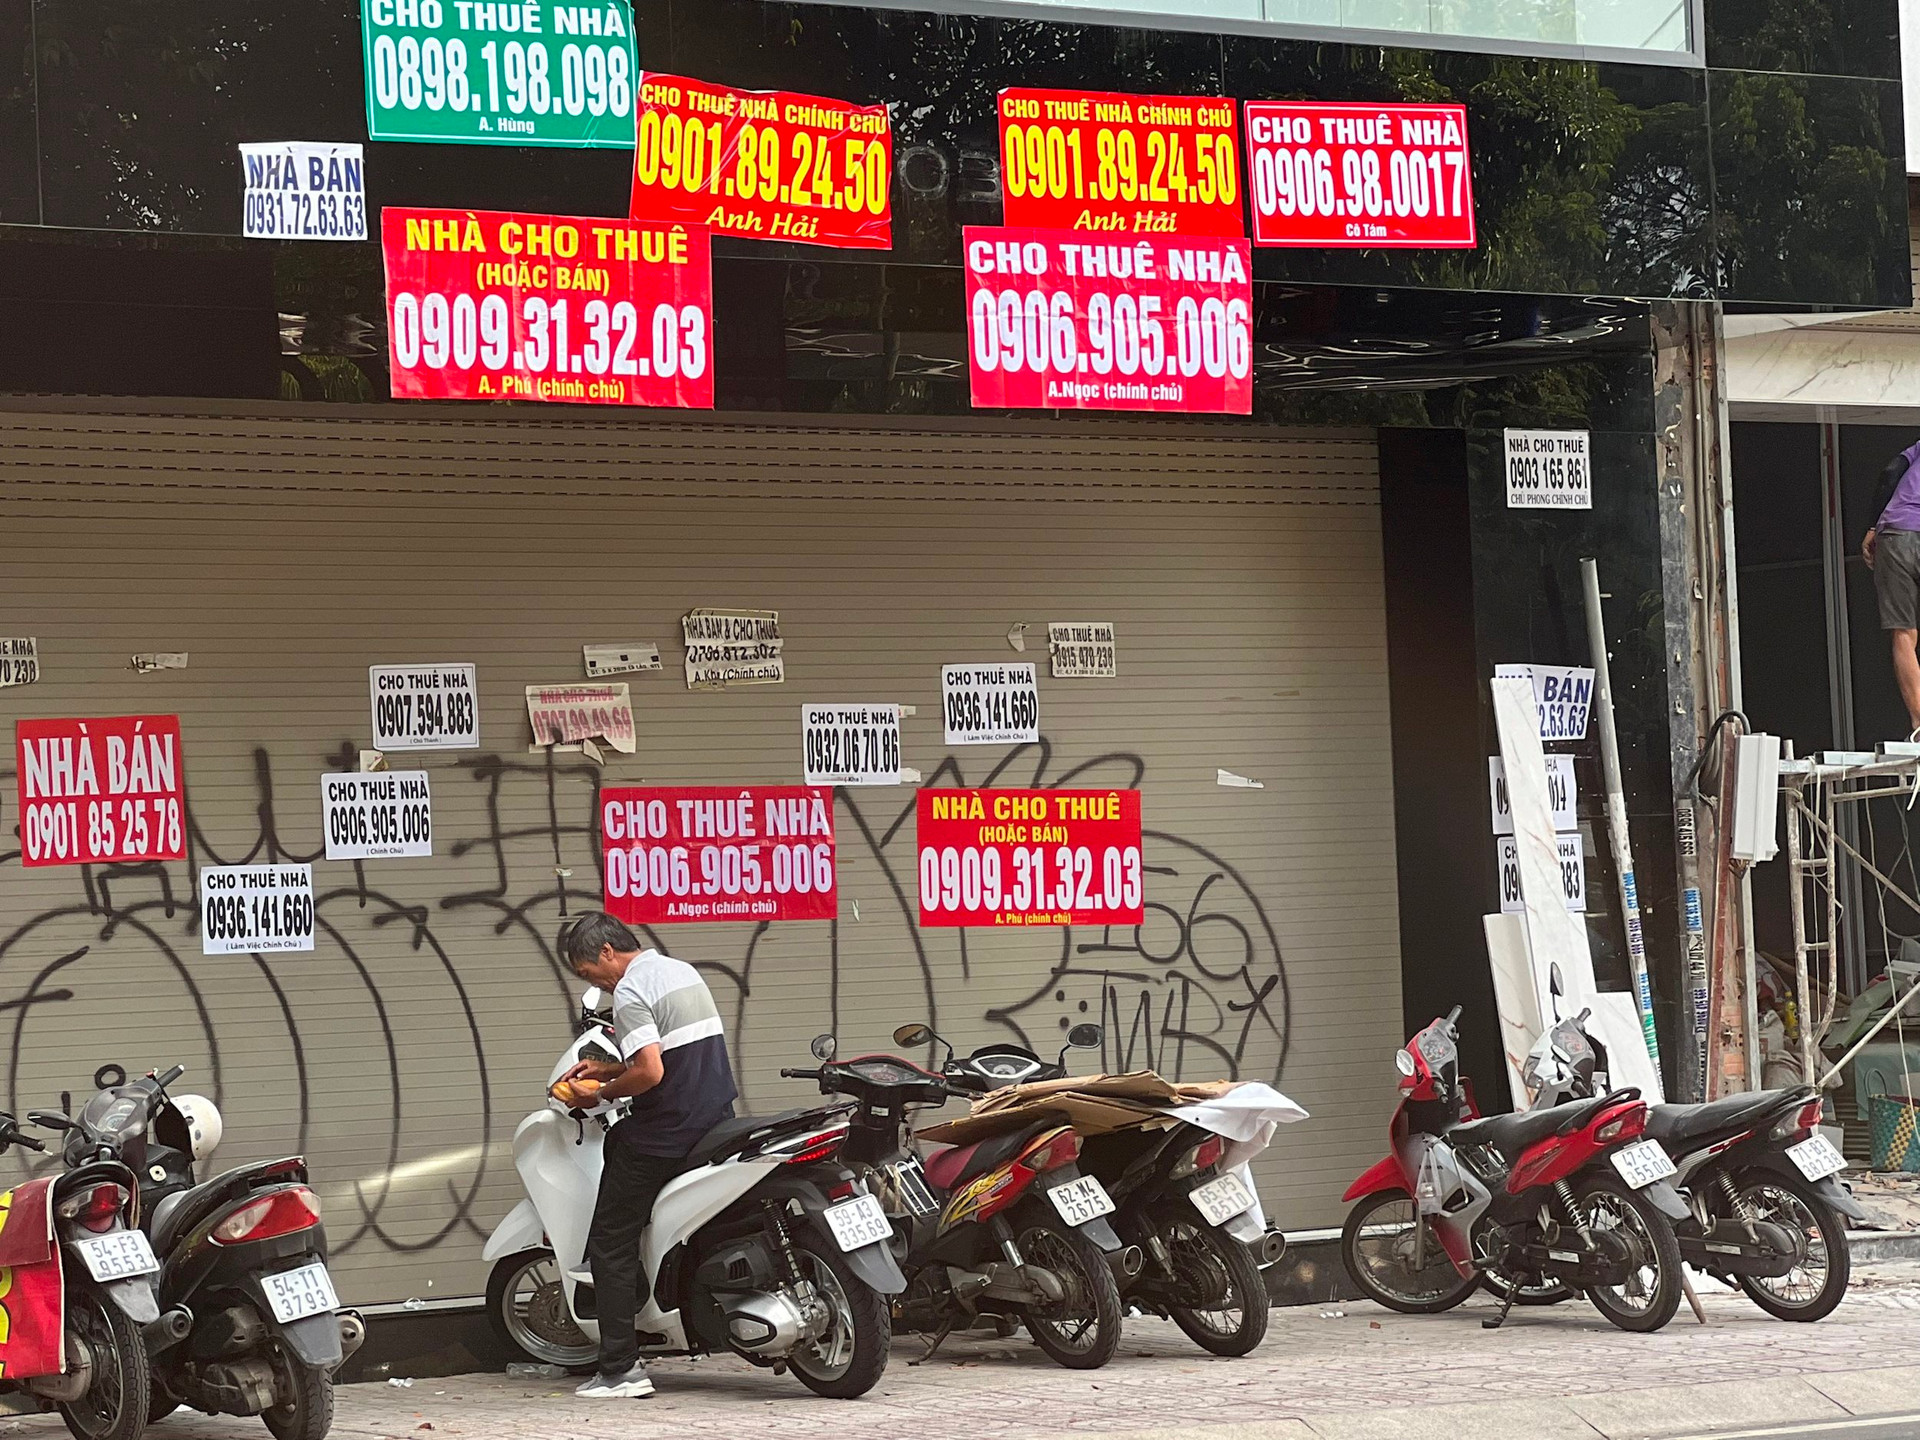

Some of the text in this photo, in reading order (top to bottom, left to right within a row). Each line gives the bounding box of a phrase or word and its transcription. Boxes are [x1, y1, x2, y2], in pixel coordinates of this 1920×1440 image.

[371, 0, 627, 38] CHO THUÊ NHÀ
[375, 35, 631, 117] 0898.198.098
[642, 83, 887, 136] CHO THUÊ NHÀ CHÍNH CHỦ
[1003, 97, 1233, 128] CHO THUÊ NHÀ CHÍNH CHỦ
[479, 117, 535, 135] A. Hùng
[1252, 114, 1463, 147] CHO THUÊ NHÀ
[246, 146, 362, 192] NHÀ BÁN
[637, 110, 888, 215] 0901.89.24.50
[1005, 123, 1237, 205] 0901.89.24.50
[1253, 147, 1466, 218] 0906.98.0017
[246, 191, 364, 237] 0931.72.63.63
[706, 205, 819, 239] Anh Hải
[1074, 208, 1178, 233] Anh Hải
[1345, 222, 1387, 237] Cô Tám
[406, 212, 690, 265] NHÀ CHO THUÊ
[968, 240, 1249, 285] CHO THUÊ NHÀ
[476, 260, 611, 297] (HOẶC BÁN)
[393, 292, 707, 380] 0909.31.32.03
[971, 288, 1250, 380] 0906.905.006
[479, 377, 626, 402] A. Phú (chính chủ)
[1048, 381, 1183, 403] A.Ngọc (chính chủ)
[1509, 434, 1584, 453] NHÀ CHO THUÊ
[1510, 457, 1588, 489] 0903 165 861
[1527, 494, 1551, 504] PHONG
[733, 618, 753, 641] CHO
[1053, 625, 1112, 642] CHO THUÊ NHÀ
[378, 669, 468, 690] CHO THUÊ NHÀ
[723, 664, 781, 682] (Chính chủ)
[946, 667, 1033, 686] CHO THUÊ NHÀ
[1544, 671, 1591, 704] BÁN
[377, 692, 474, 737] 0907.594.883
[809, 708, 895, 725] CHO THUÊ NHÀ
[947, 690, 1037, 731] 0936.141.660
[1536, 703, 1587, 737] 2.63.63
[22, 720, 177, 798] NHÀ BÁN
[807, 728, 899, 773] 0932.06.70.86
[329, 775, 430, 802] CHO THUÊ NHÀ
[604, 790, 831, 840] CHO THUÊ NHÀ
[932, 791, 1121, 820] NHÀ CHO THUÊ
[26, 797, 182, 860] 0901 85 25 78
[330, 804, 431, 846] 0906.905.006
[979, 823, 1069, 846] (HOẶC BÁN)
[206, 867, 309, 891] CHO THUÊ NHÀ
[607, 844, 833, 897] 0906.905.006
[920, 846, 1141, 911] 0909.31.32.03
[207, 894, 312, 940] 0936.141.660
[667, 899, 777, 916] A.Ngọc (chính chủ)
[995, 914, 1004, 924] A.
[1006, 912, 1022, 924] Phú
[1025, 913, 1052, 925] (chính
[1053, 911, 1072, 925] chủ)
[1199, 1177, 1236, 1205] 65-P5
[833, 1201, 873, 1227] 59-A3
[1067, 1197, 1106, 1221] 2675
[90, 1235, 140, 1258] 54-F3
[840, 1218, 886, 1247] 335.69
[99, 1253, 149, 1277] 9553
[272, 1270, 319, 1297] 54-T1
[280, 1290, 329, 1317] 3793
